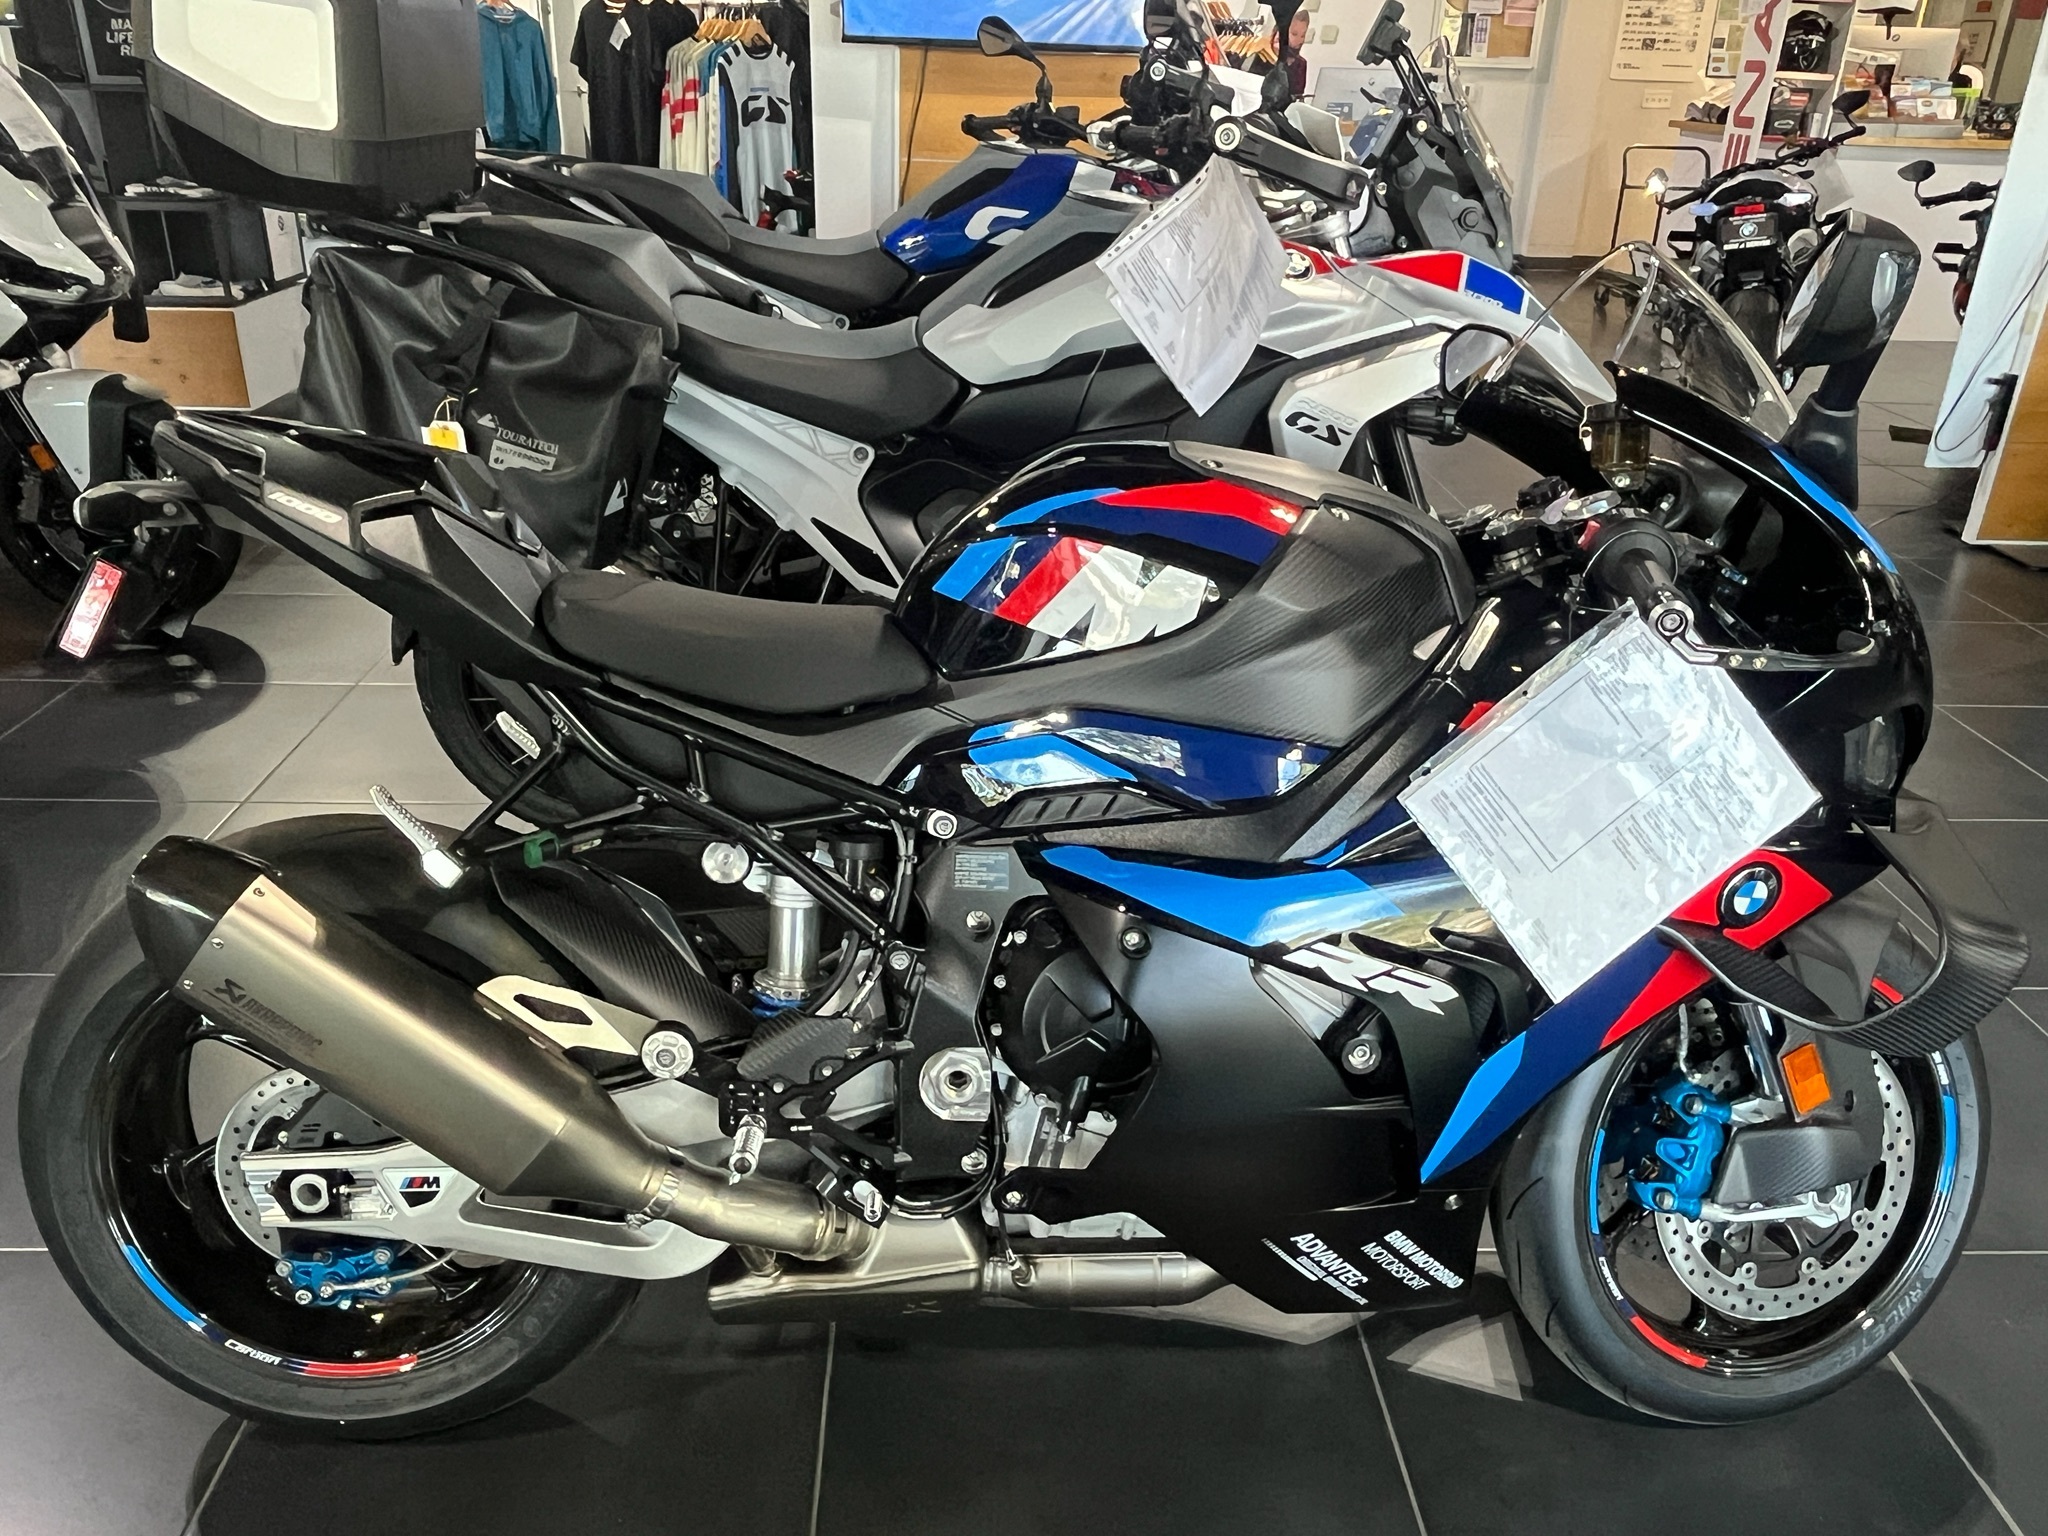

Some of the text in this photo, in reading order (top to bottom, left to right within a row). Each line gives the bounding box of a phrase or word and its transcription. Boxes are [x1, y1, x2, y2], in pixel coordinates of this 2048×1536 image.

[105, 31, 134, 44] LIFE
[110, 18, 133, 30] MA
[1285, 411, 1352, 446] GS
[267, 491, 343, 523] 1000
[1290, 1233, 1369, 1287] ADVANTEC
[1384, 1230, 1420, 1260] BMW
[1360, 1242, 1431, 1290] MOTORSPORT
